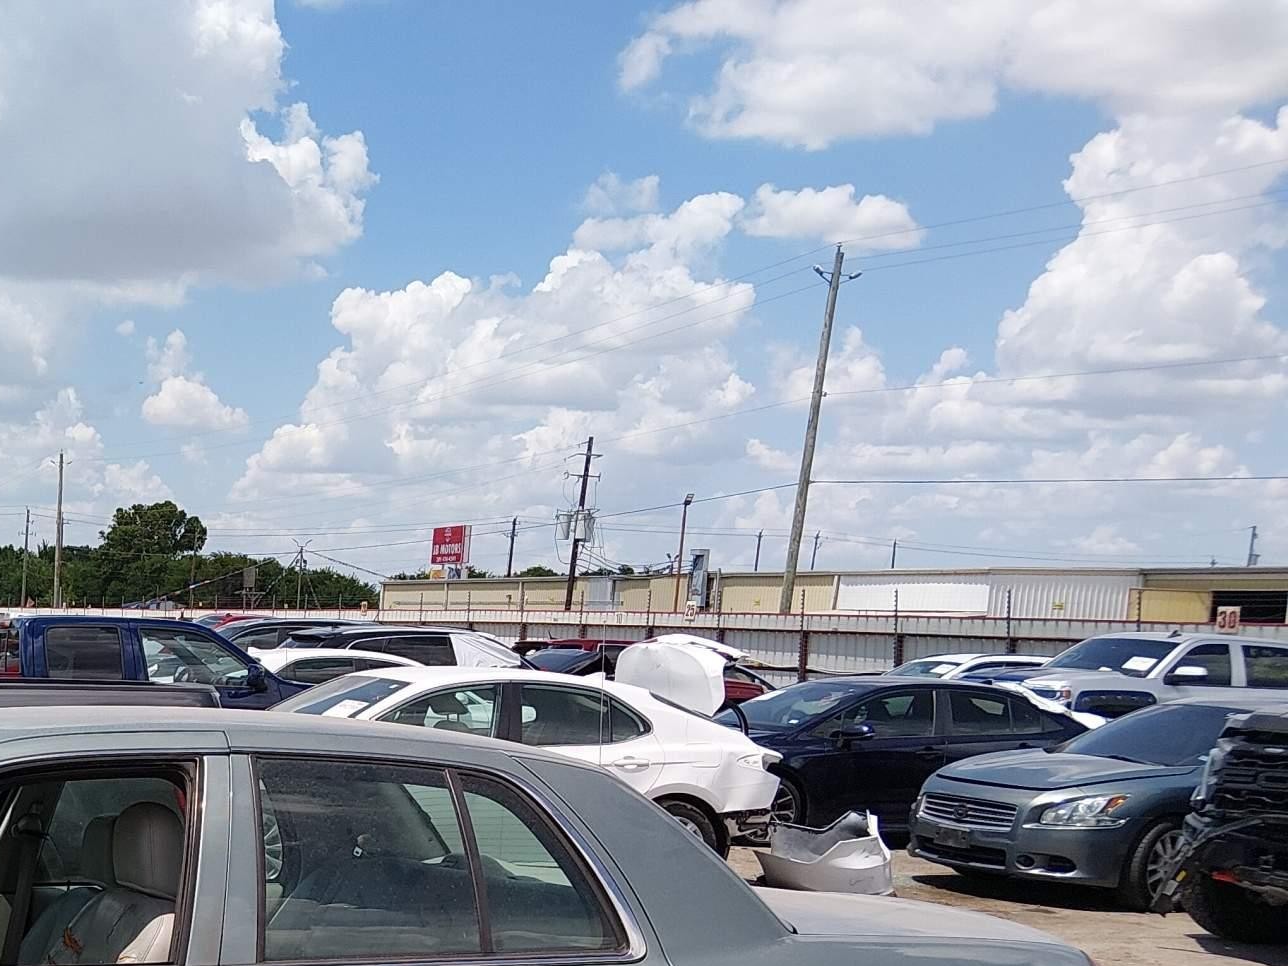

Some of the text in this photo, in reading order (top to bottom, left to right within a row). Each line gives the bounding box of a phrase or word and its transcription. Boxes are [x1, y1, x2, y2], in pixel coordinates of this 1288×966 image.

[440, 542, 461, 555] MOTORS
[685, 604, 696, 617] 25
[1218, 610, 1238, 629] 30
